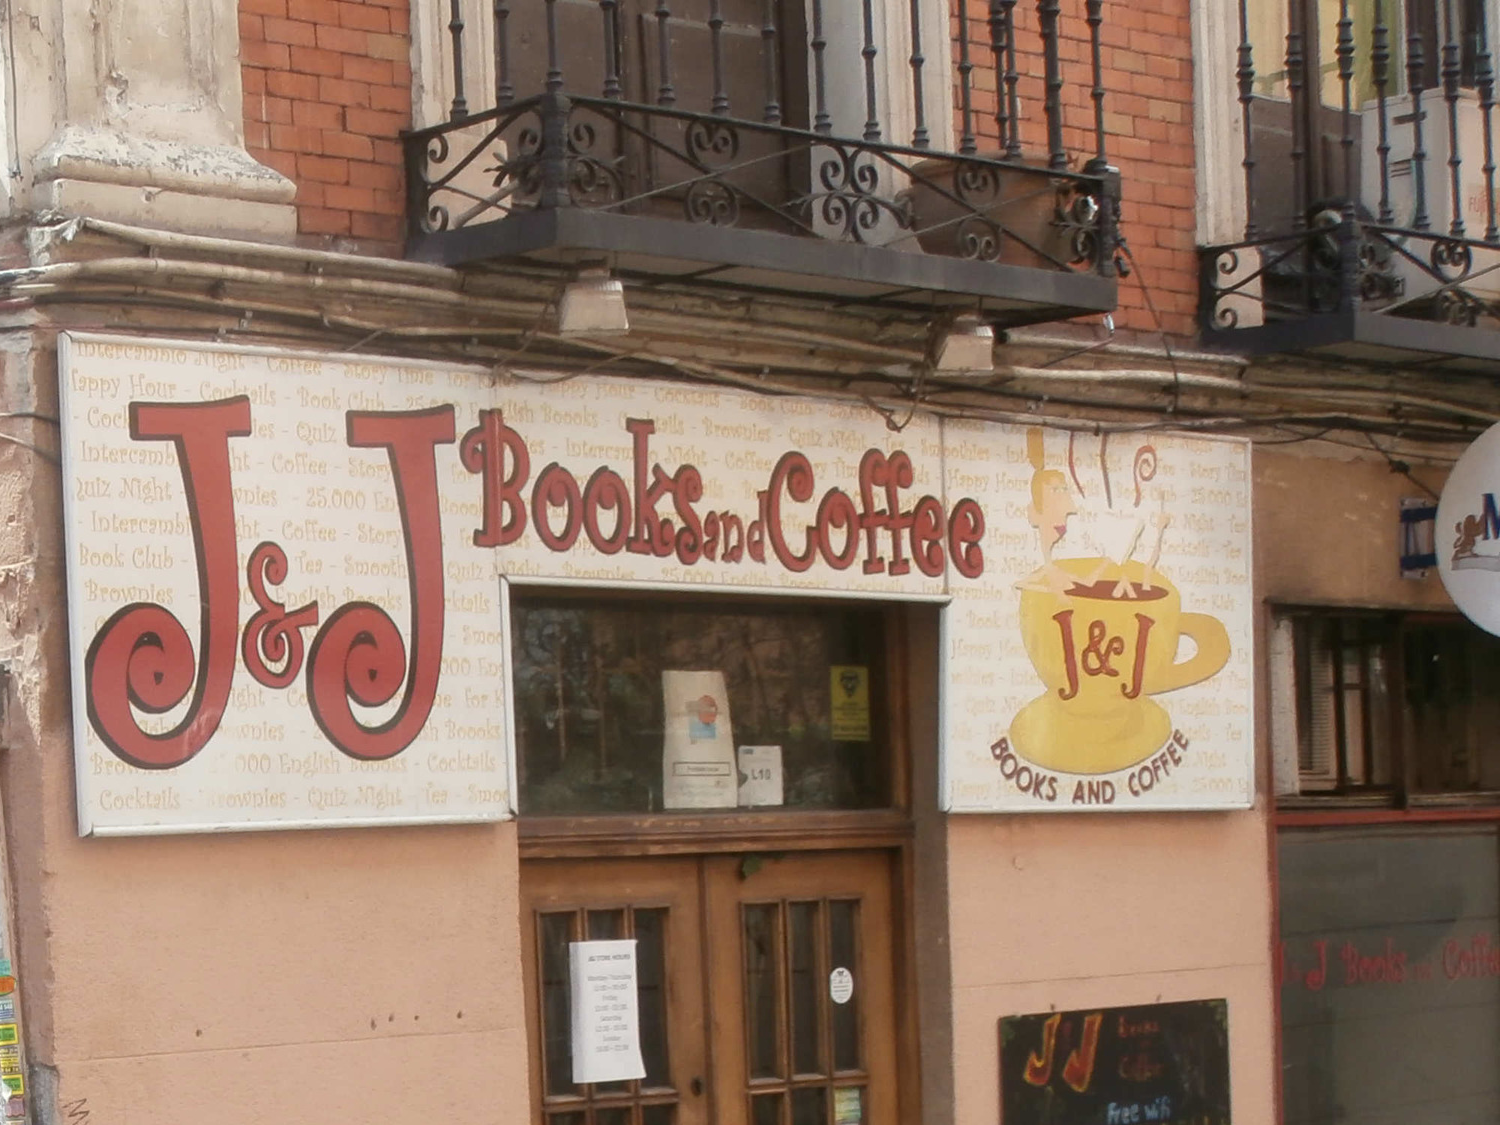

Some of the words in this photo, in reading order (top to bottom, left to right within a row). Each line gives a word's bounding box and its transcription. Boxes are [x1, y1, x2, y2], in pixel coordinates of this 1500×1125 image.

[130, 373, 177, 399] Hour
[297, 385, 342, 410] Book
[296, 422, 337, 446] Quiz
[271, 452, 328, 476] Coffee
[118, 477, 173, 504] Night
[306, 485, 366, 511] 25.000
[459, 407, 704, 566] Books
[702, 489, 767, 565] and
[766, 446, 987, 579] Coffee
[281, 519, 338, 542] Coffee
[78, 542, 125, 569] Book
[132, 545, 174, 571] Club
[84, 579, 174, 604] Brownies
[427, 749, 497, 773] Cocktails
[990, 736, 1058, 802] BOOKS
[1071, 780, 1116, 804] AND
[1127, 729, 1190, 798] COFFEE
[99, 785, 181, 811] Cocktails
[308, 784, 348, 810] Quiz
